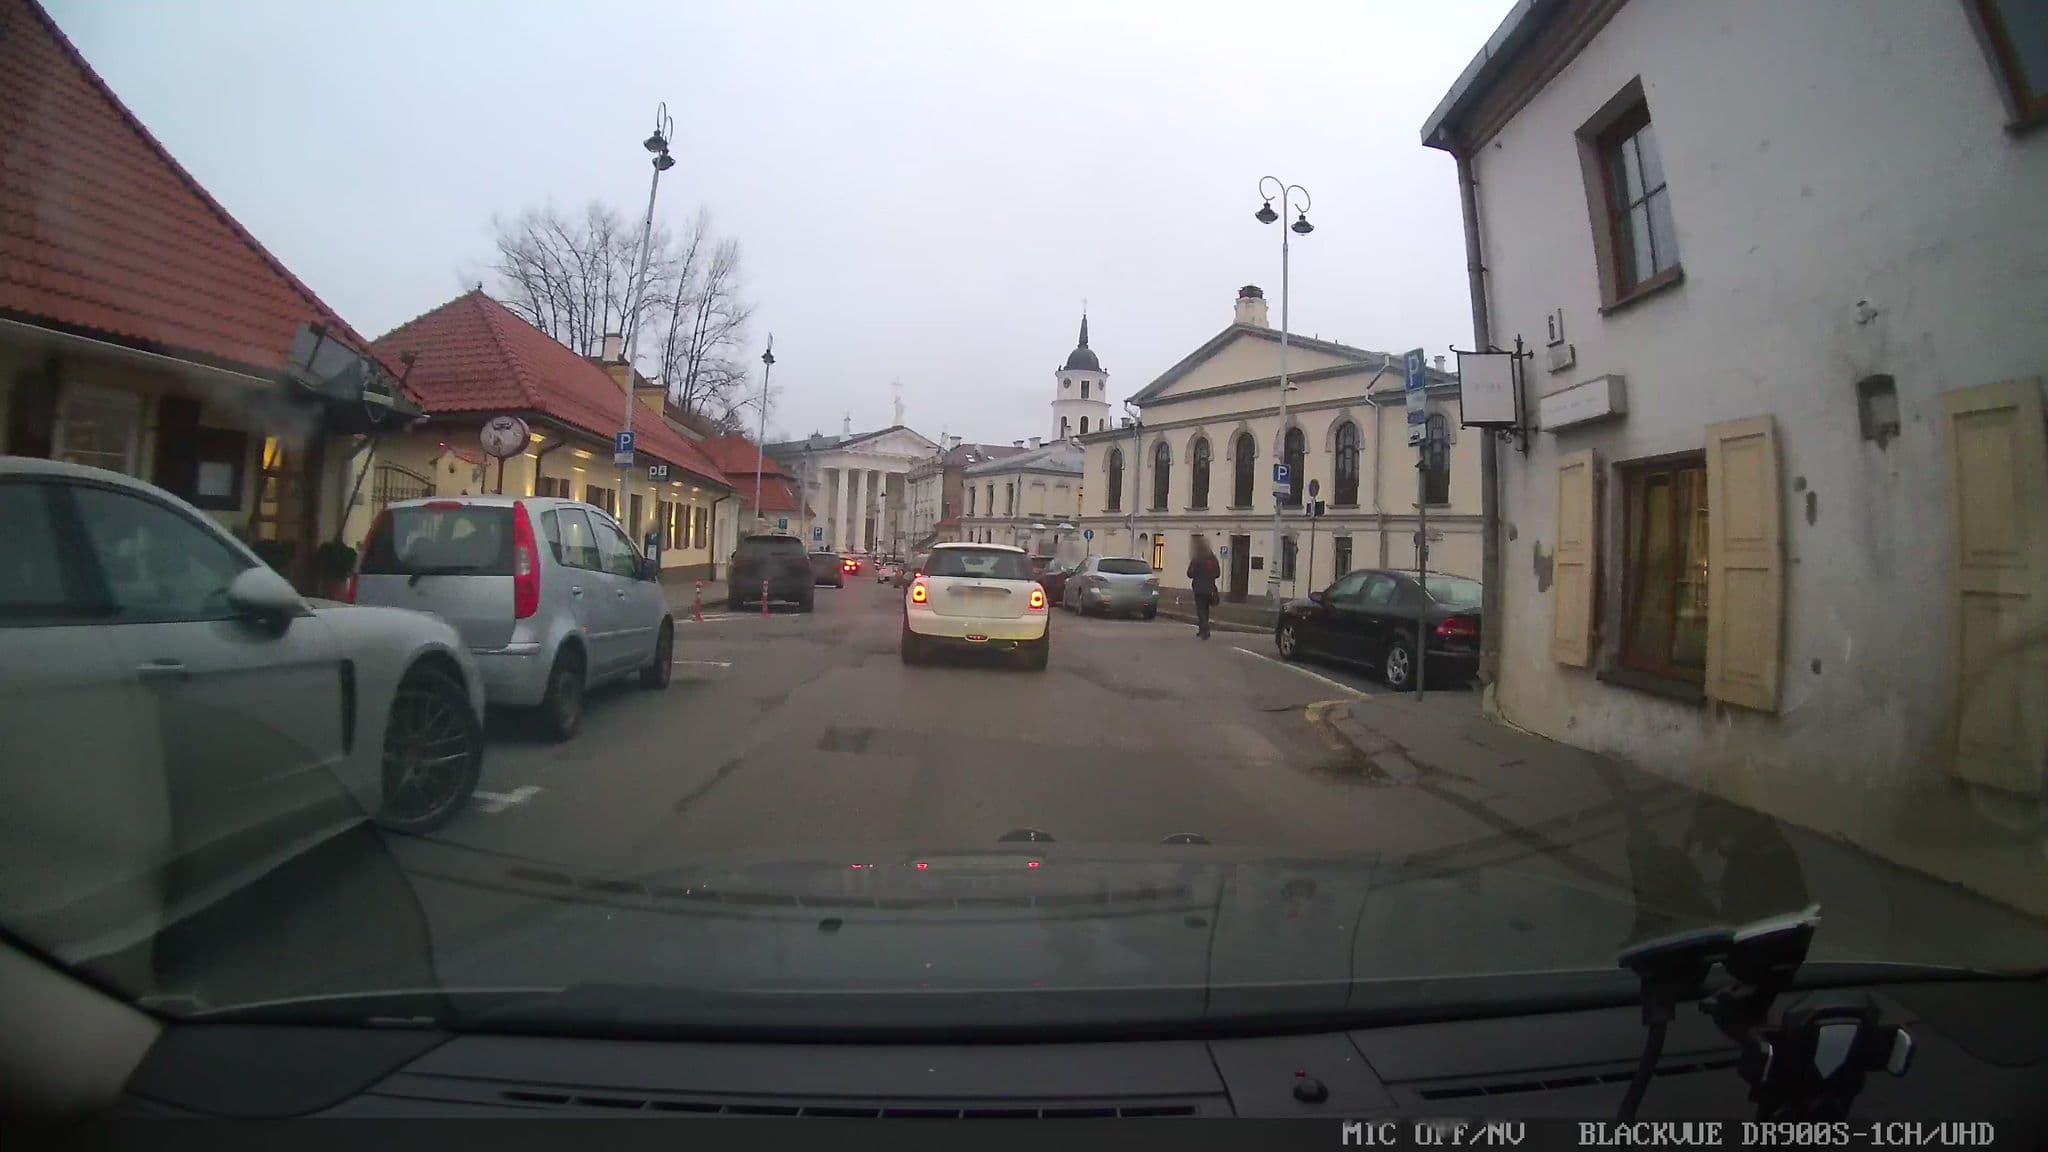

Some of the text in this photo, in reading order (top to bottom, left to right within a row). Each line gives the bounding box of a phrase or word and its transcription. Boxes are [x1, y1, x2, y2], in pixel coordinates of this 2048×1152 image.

[1407, 354, 1419, 386] P
[620, 434, 631, 450] P
[1277, 466, 1288, 480] P
